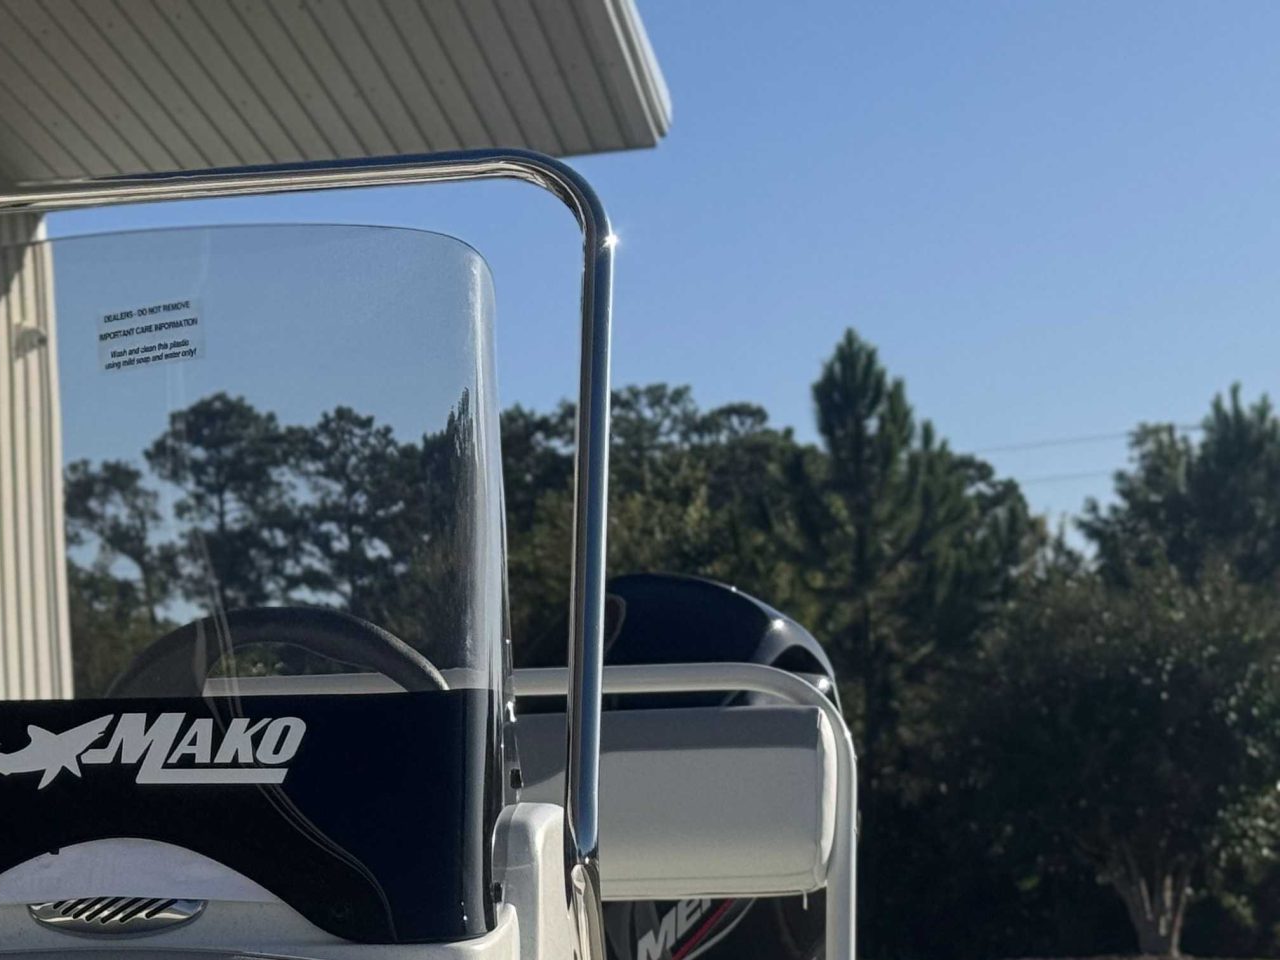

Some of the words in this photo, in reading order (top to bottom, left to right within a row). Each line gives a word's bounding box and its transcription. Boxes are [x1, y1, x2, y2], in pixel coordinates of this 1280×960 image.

[104, 310, 134, 323] DEALERS
[137, 308, 147, 318] DO
[148, 306, 162, 316] NOT
[163, 300, 190, 312] REMOVE
[99, 327, 135, 341] IMPORTANT
[136, 324, 153, 336] CARE
[154, 318, 198, 332] INFORMATION
[105, 361, 121, 370] using
[122, 358, 135, 367] mild
[152, 353, 163, 362] and
[164, 350, 181, 361] water
[111, 347, 127, 358] Wash
[128, 346, 140, 356] and
[140, 344, 157, 355] clean
[158, 341, 168, 352] this
[169, 339, 190, 351] plastic
[81, 712, 307, 784] MAKO
